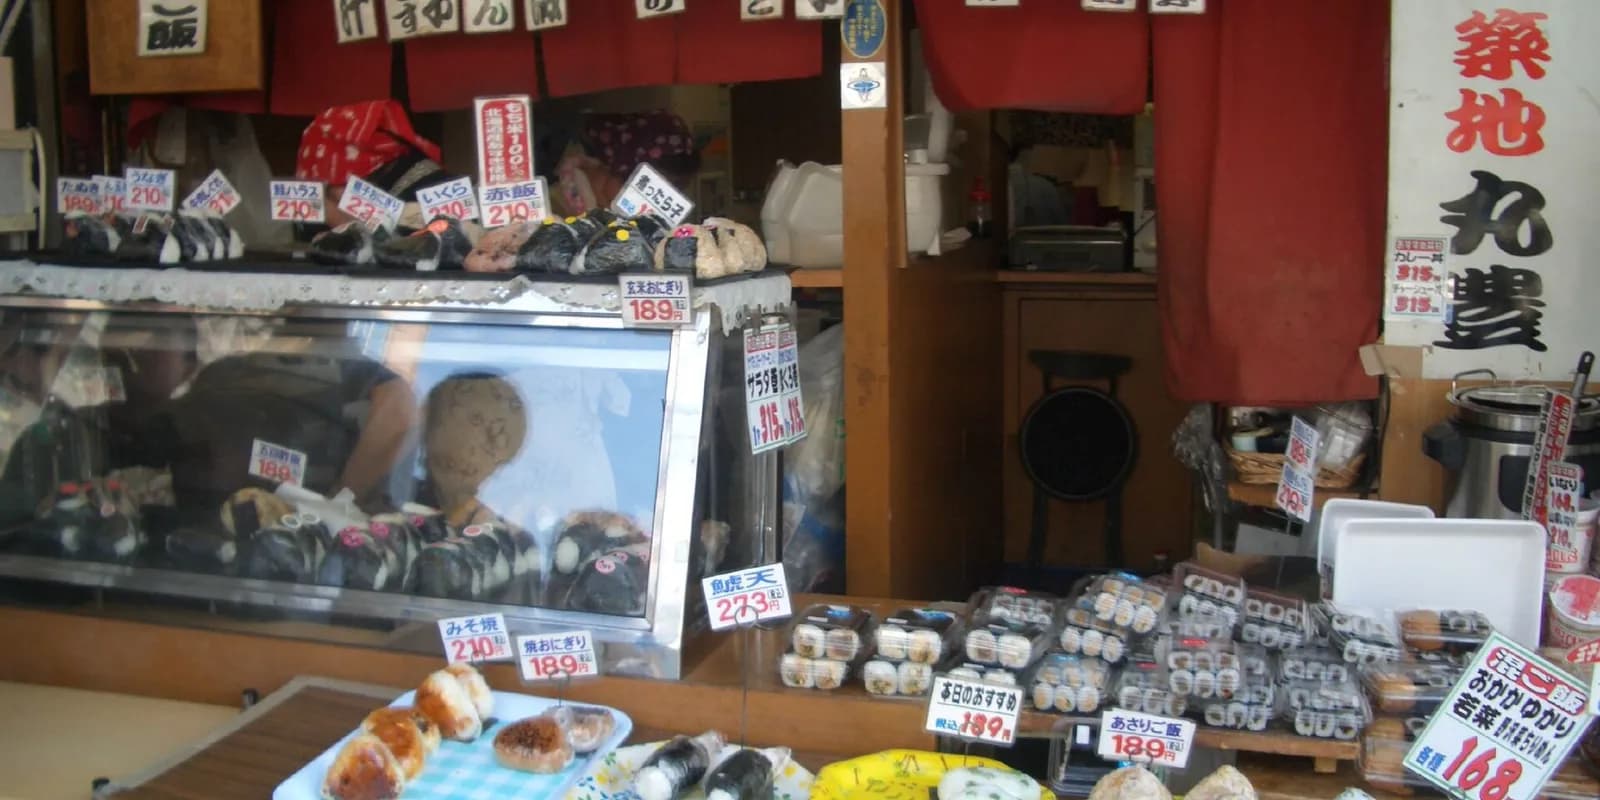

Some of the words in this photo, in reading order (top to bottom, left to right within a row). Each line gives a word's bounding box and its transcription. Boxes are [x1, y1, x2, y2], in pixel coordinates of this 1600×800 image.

[422, 182, 467, 204] いくら
[485, 182, 537, 200] 赤飯
[446, 617, 498, 636] みそ焼
[525, 636, 586, 653] 焼おにぎり
[940, 681, 1017, 711] 本日のおすすめ
[1111, 716, 1183, 737] あさりご飯
